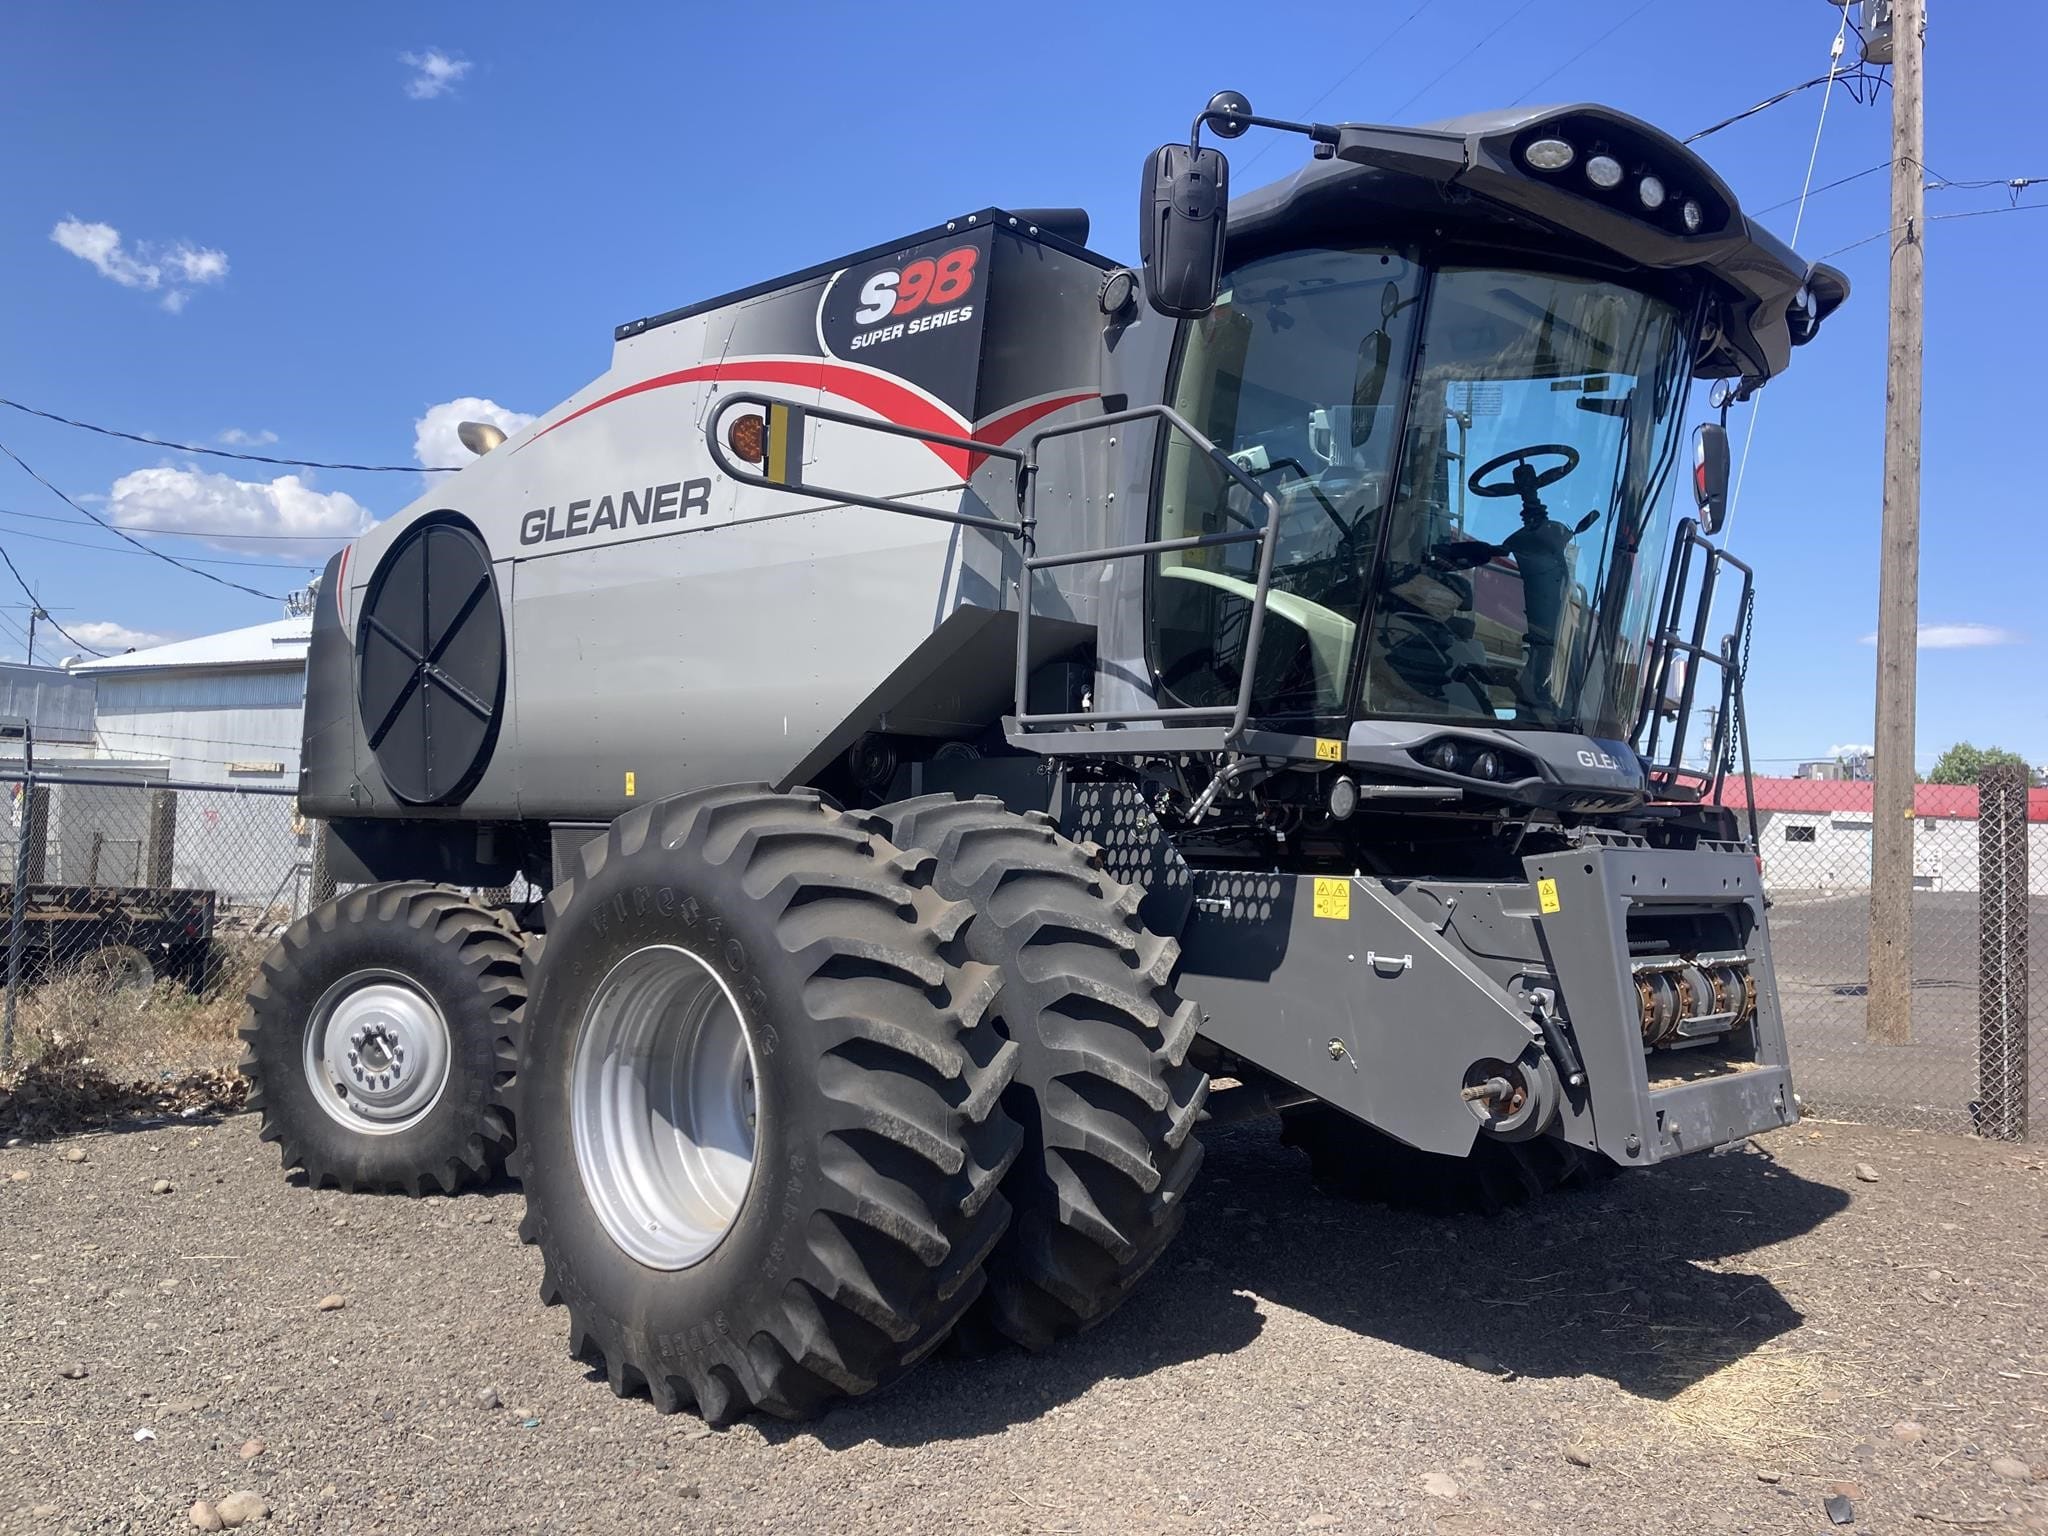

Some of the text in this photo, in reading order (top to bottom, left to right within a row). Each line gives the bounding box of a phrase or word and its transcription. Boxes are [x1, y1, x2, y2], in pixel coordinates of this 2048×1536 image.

[856, 247, 978, 325] S98
[850, 306, 973, 350] SUPER SERIES
[520, 477, 711, 546] GLEANER
